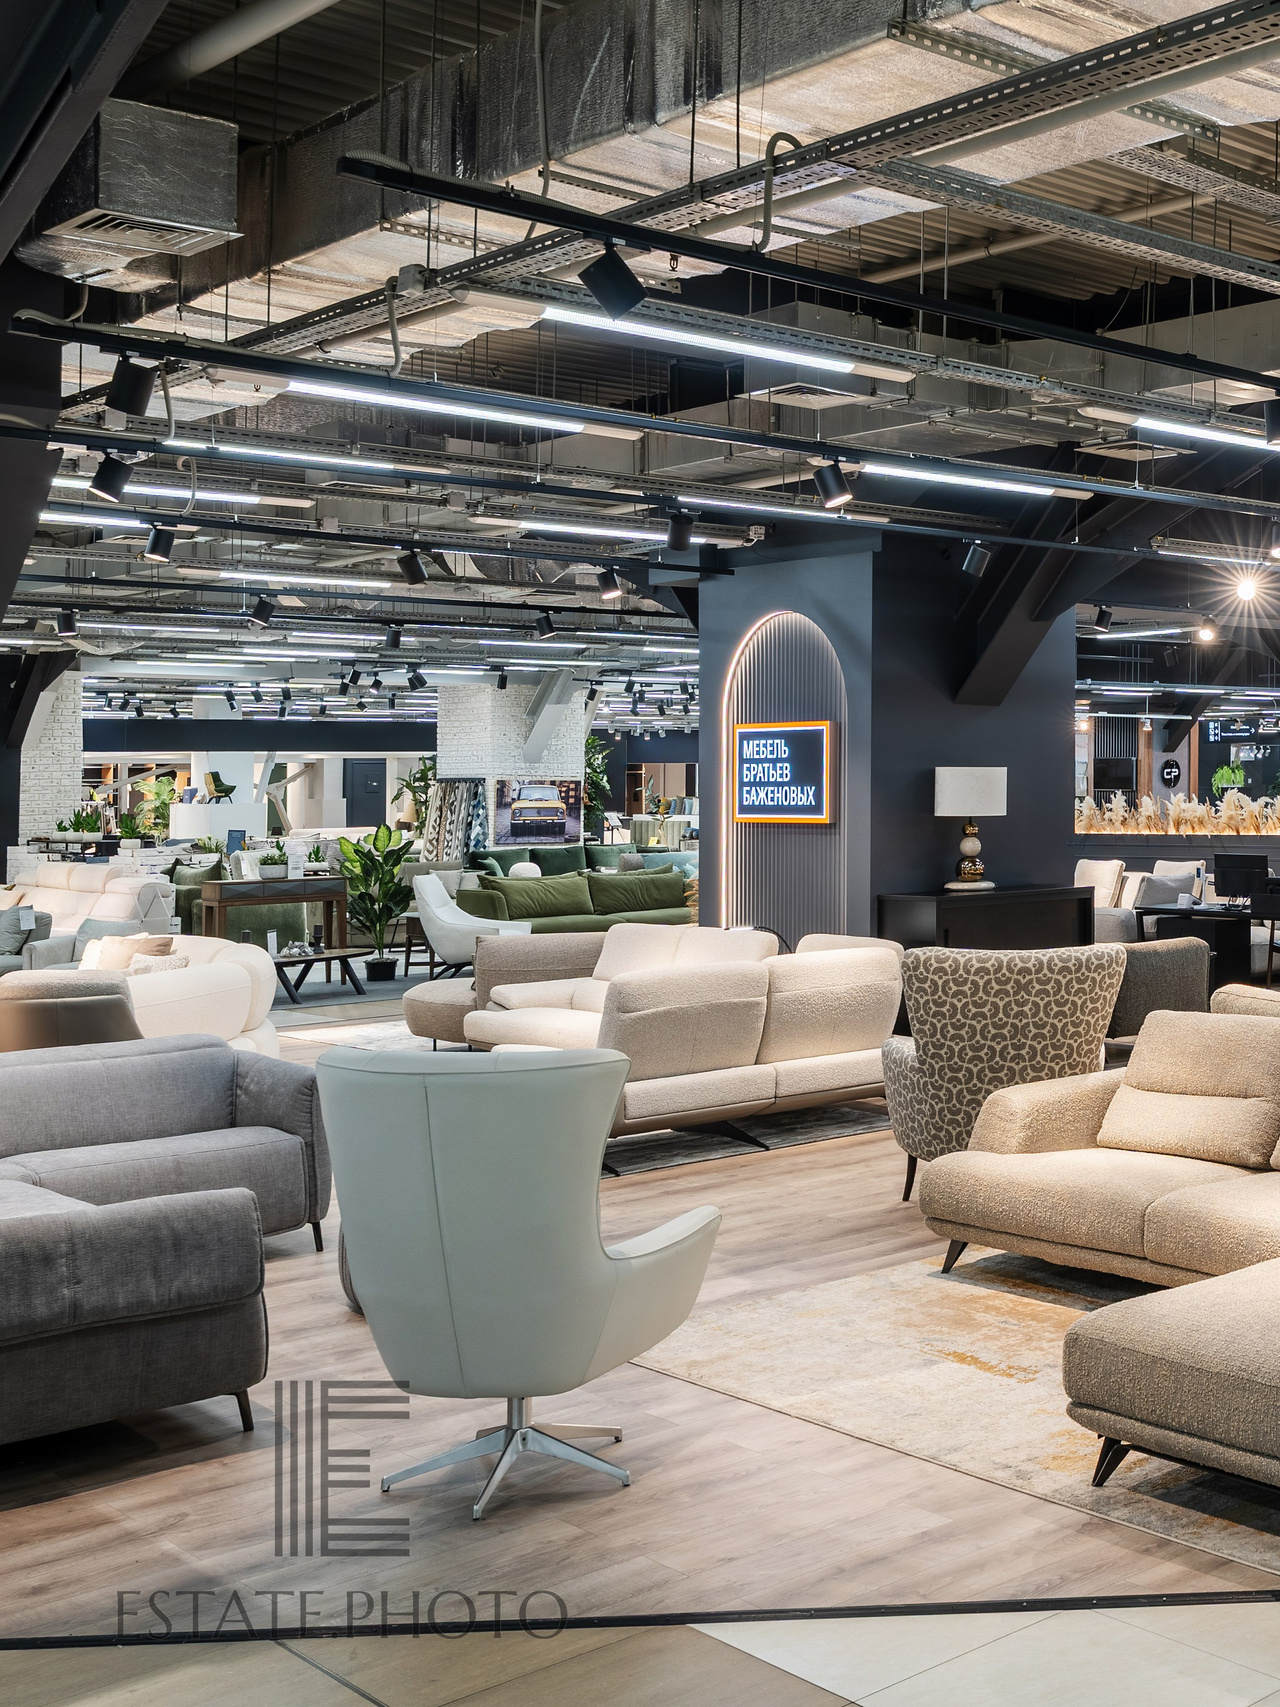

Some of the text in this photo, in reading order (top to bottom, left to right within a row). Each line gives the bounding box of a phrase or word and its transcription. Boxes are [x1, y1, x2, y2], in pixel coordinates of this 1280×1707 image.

[743, 739, 789, 759] МЕБЕЛЬ
[743, 763, 791, 782] БРАТЬЕВ
[743, 786, 816, 806] БАЖЕНОВЫХ
